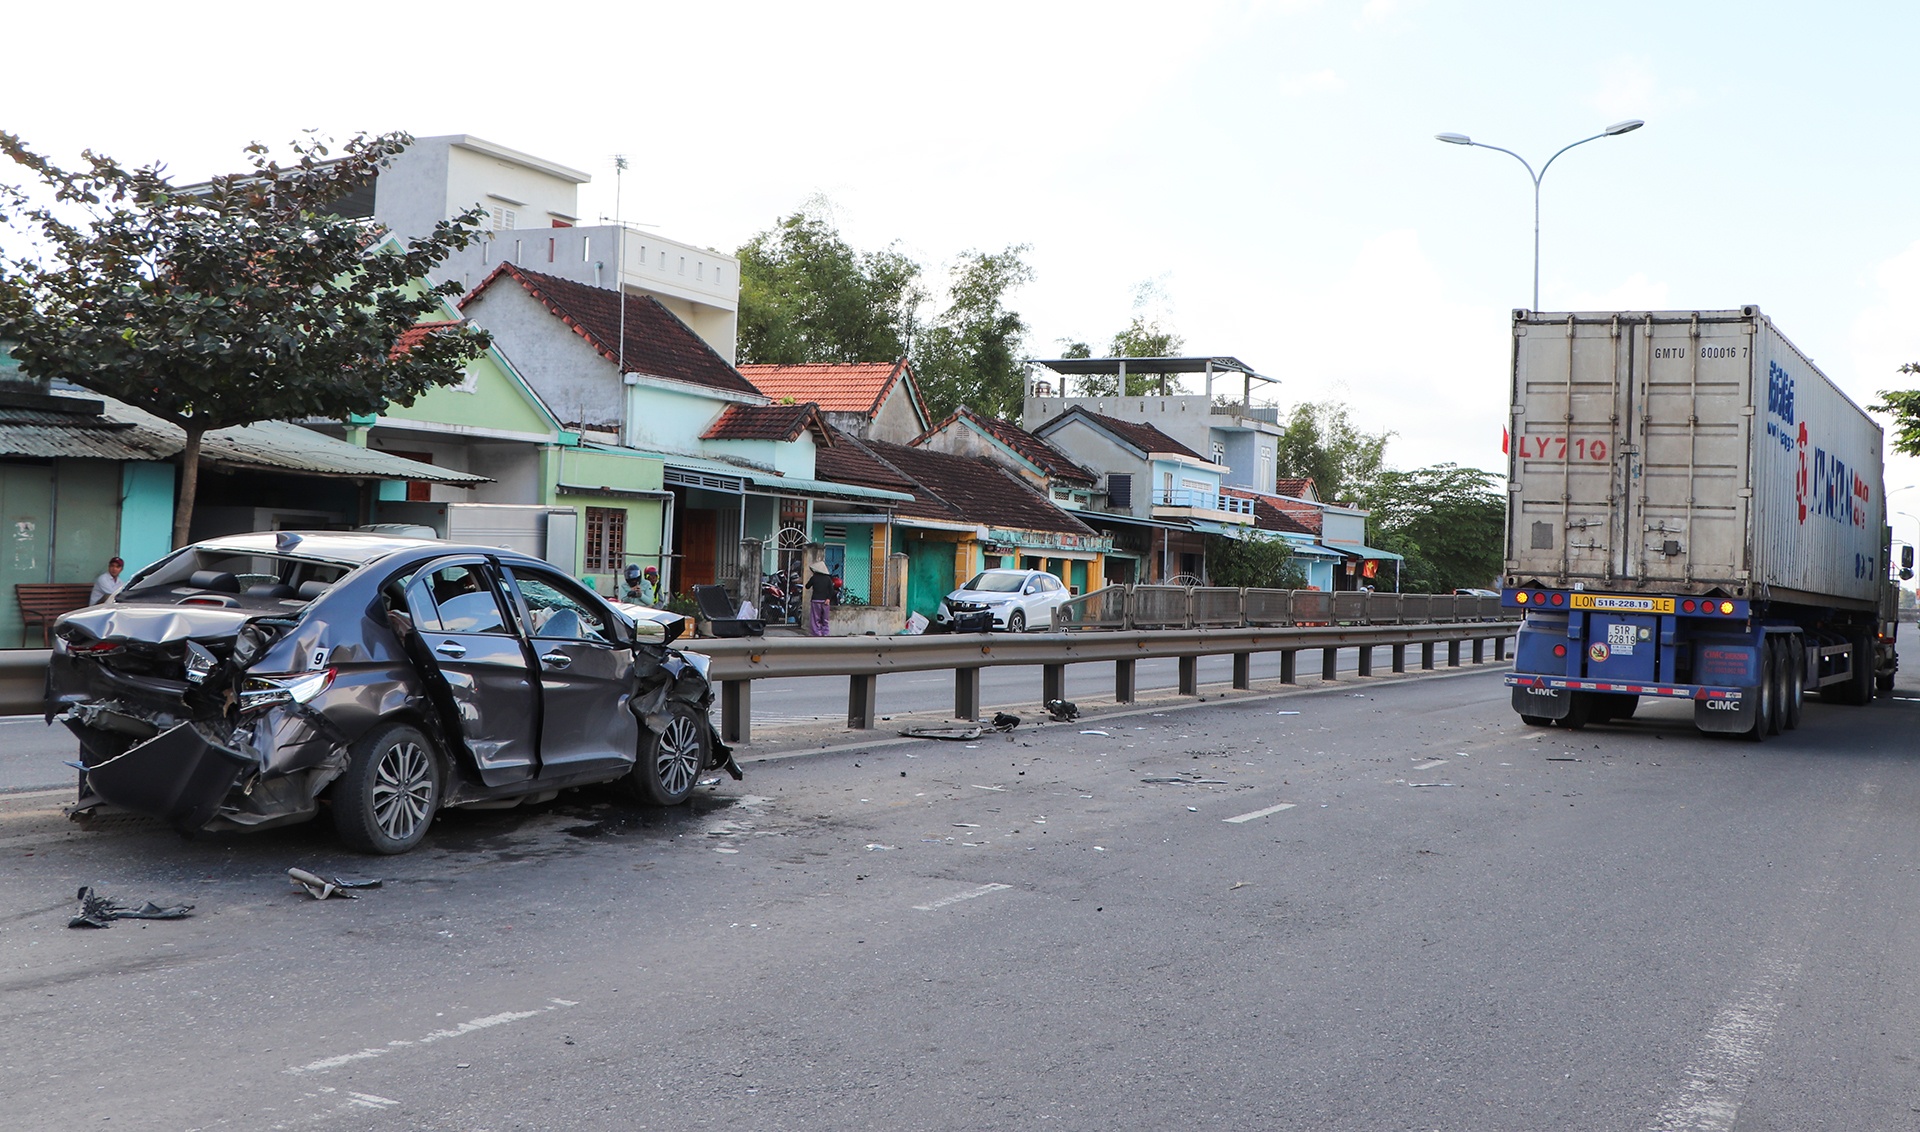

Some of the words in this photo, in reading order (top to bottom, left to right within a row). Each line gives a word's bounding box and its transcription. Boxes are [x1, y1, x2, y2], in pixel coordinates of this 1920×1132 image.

[1655, 348, 1685, 359] GMTU
[1701, 347, 1736, 359] 800016
[1742, 347, 1748, 358] 7
[1519, 436, 1606, 460] LY710
[1575, 596, 1596, 607] LON
[1598, 599, 1649, 608] 51R-228.19
[1614, 625, 1631, 635] 51R
[1609, 634, 1636, 645] 228.19
[314, 652, 324, 665] 9
[1526, 687, 1559, 697] CIMC
[1706, 700, 1740, 711] CIMC
